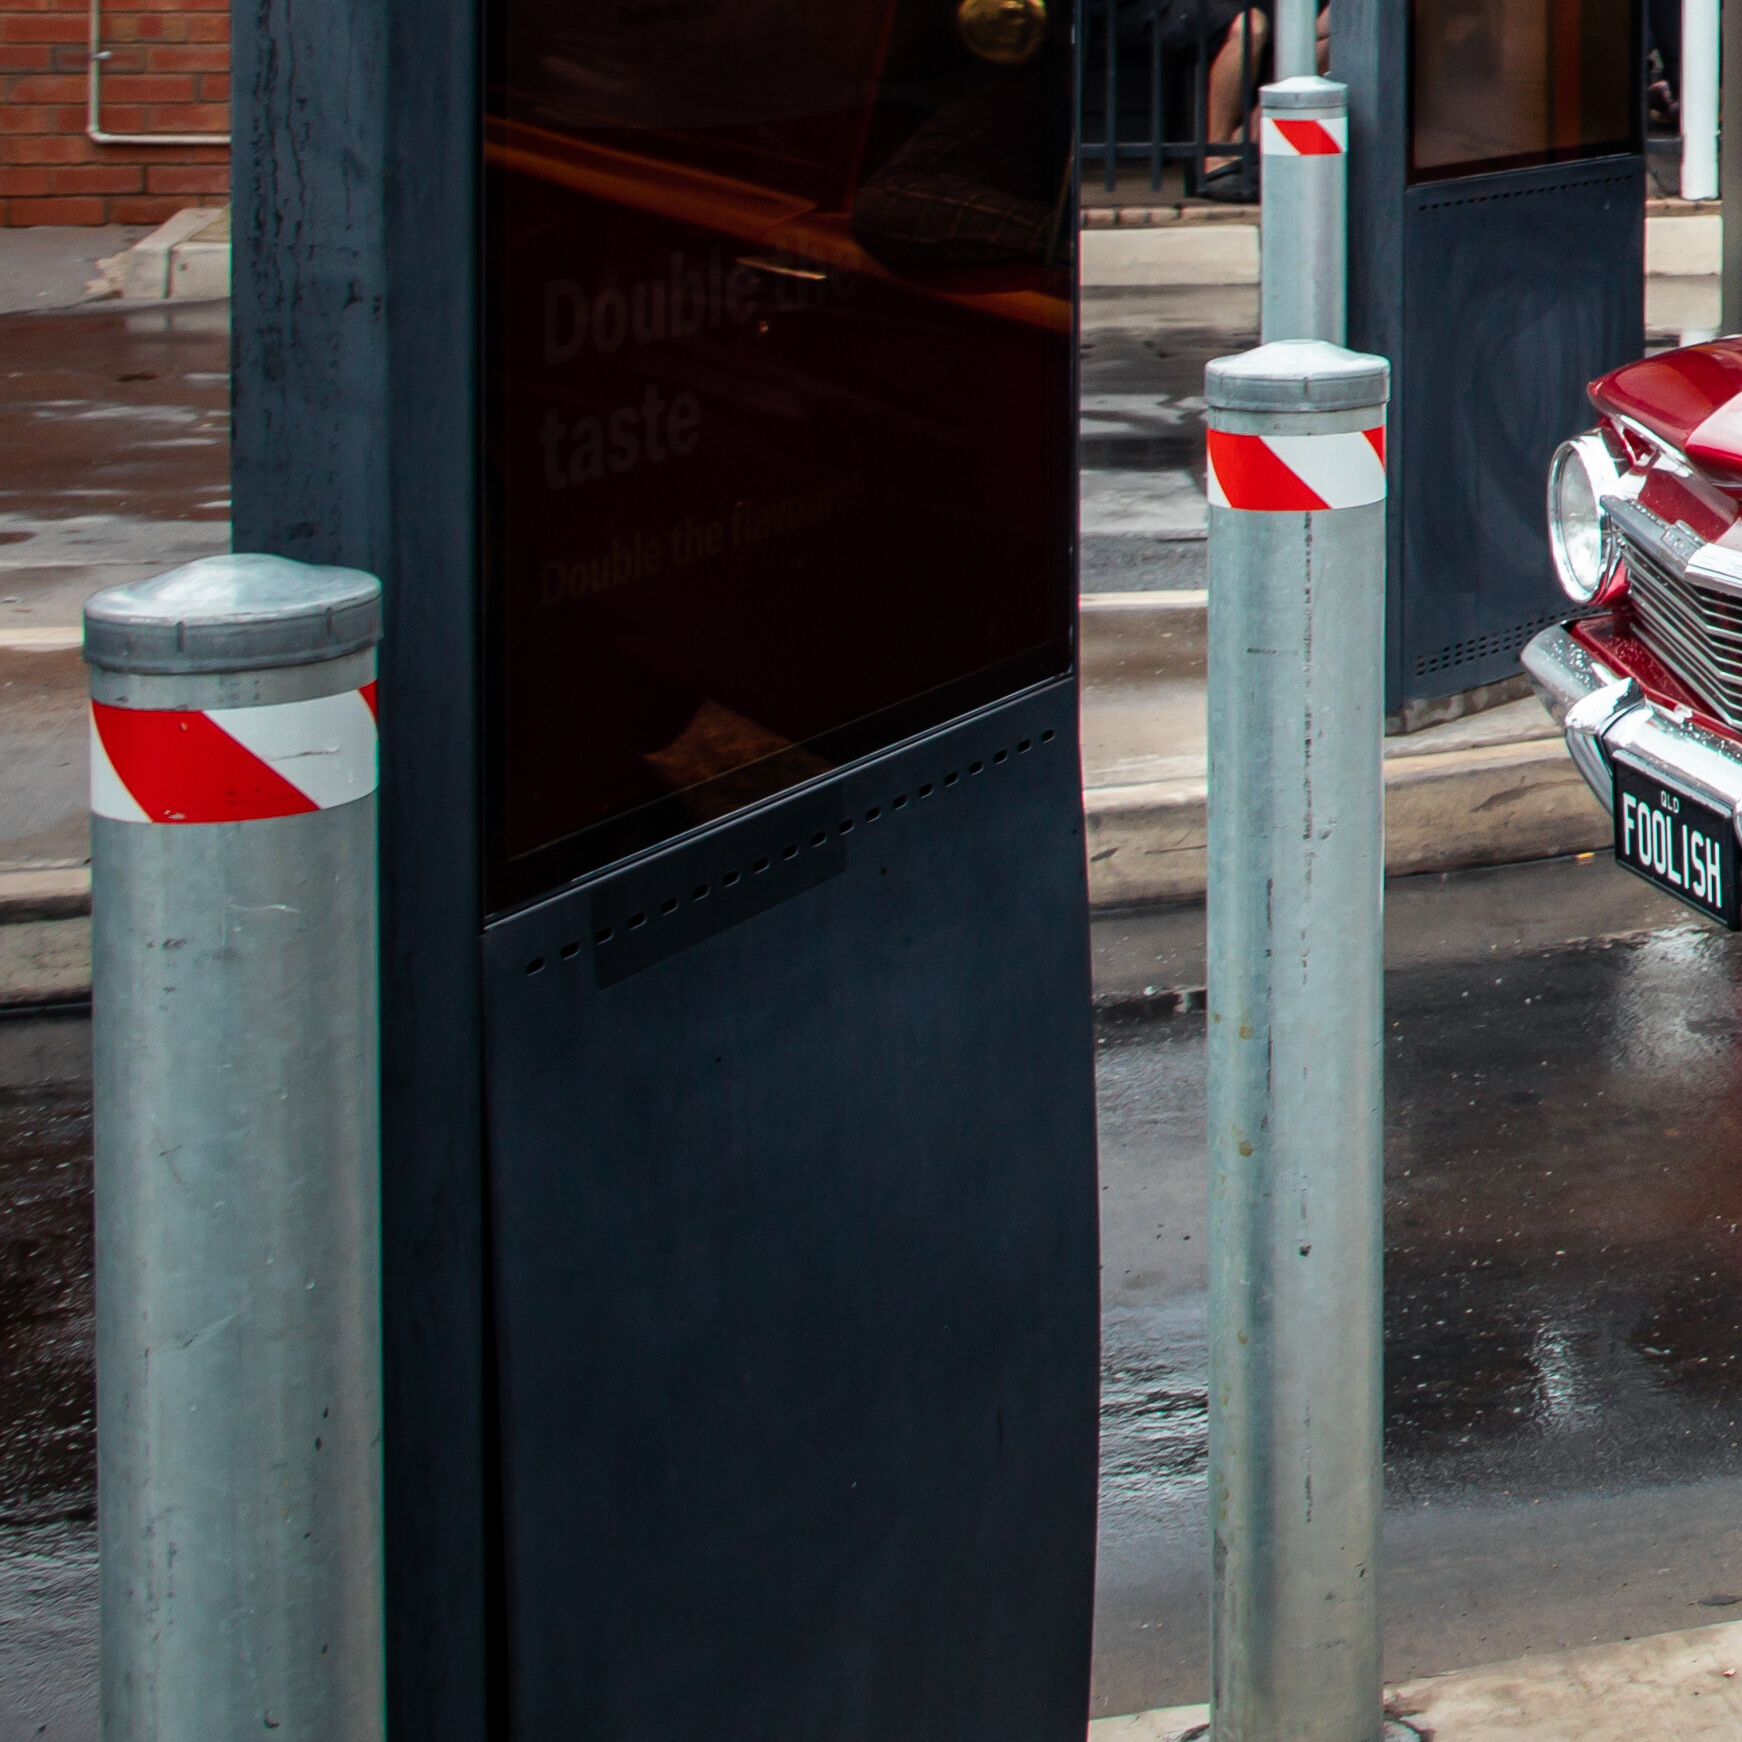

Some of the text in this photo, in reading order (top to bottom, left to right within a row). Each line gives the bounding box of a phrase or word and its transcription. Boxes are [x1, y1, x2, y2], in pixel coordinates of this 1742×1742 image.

[544, 244, 757, 366] Double
[540, 384, 701, 490] taste
[540, 532, 664, 608] Double
[1623, 792, 1722, 908] FOOLISH
[1660, 790, 1680, 814] QLD
